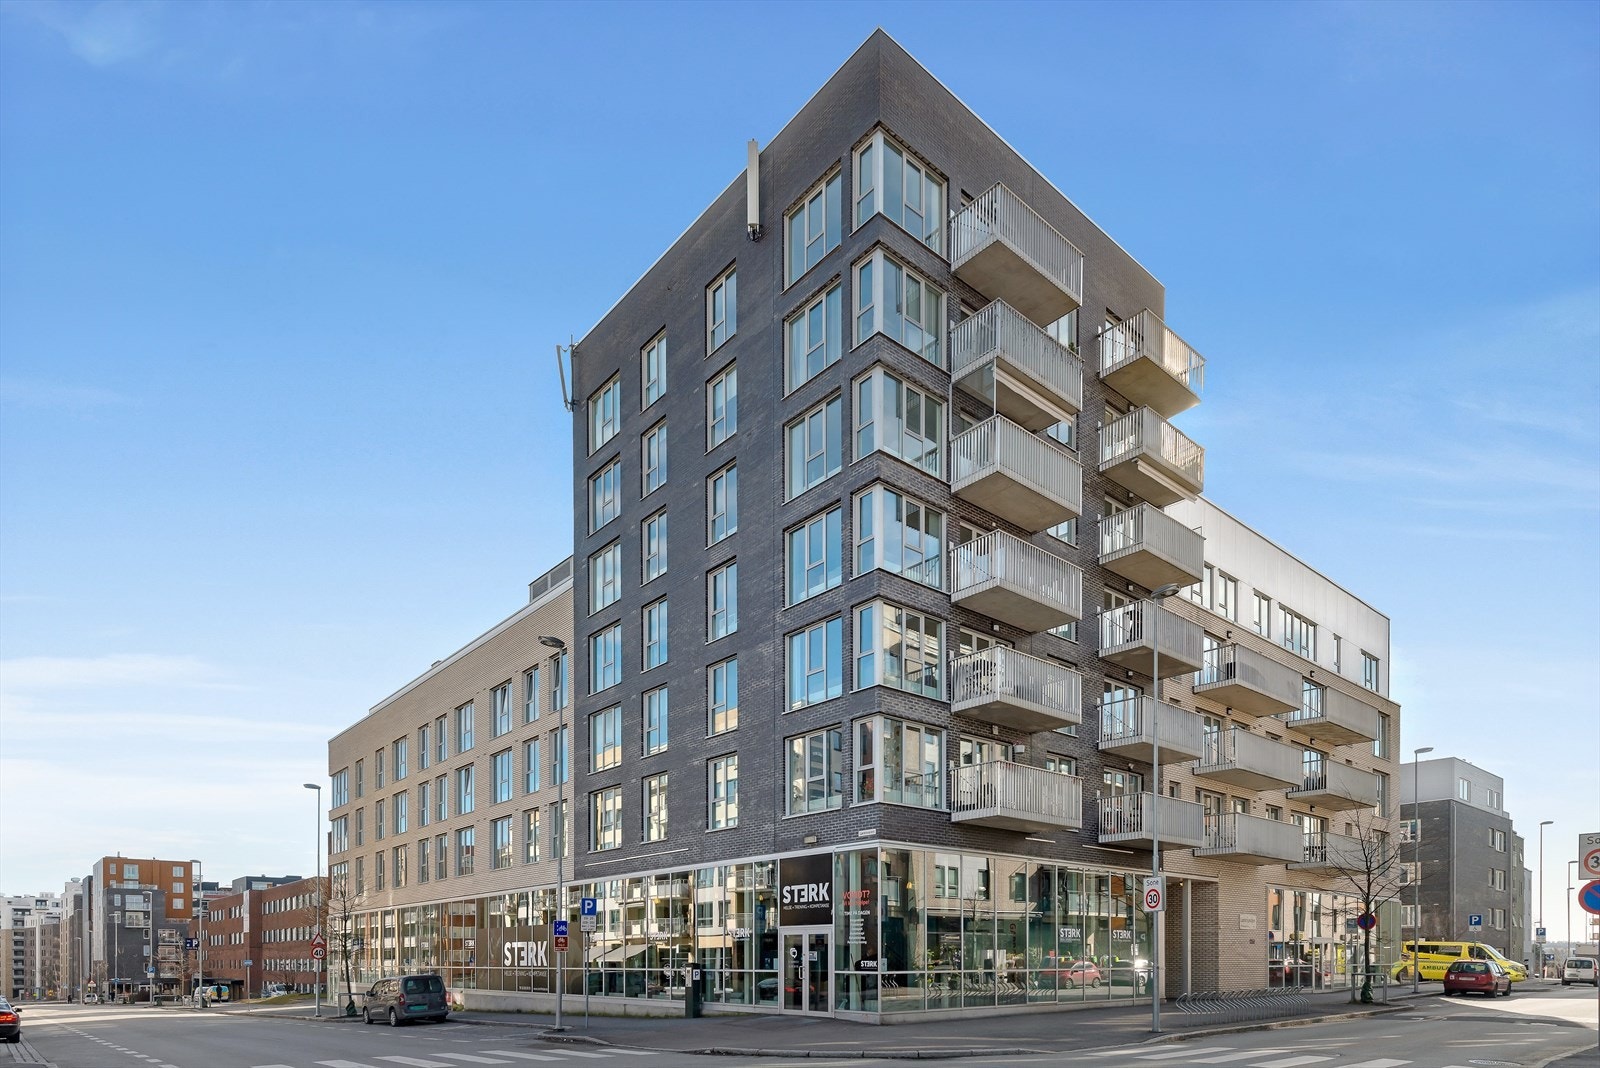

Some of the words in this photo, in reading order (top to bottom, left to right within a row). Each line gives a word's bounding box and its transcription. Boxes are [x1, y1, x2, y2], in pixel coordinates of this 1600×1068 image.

[782, 882, 830, 904] STERK
[1148, 893, 1158, 904] 30
[584, 900, 594, 914] P
[1471, 915, 1480, 925] P
[728, 927, 750, 938] STERK
[1060, 928, 1081, 938] STERK
[1112, 929, 1132, 939] STERK
[192, 939, 198, 947] P
[504, 941, 548, 967] STERK
[860, 960, 878, 968] STERK
[694, 970, 700, 978] P
